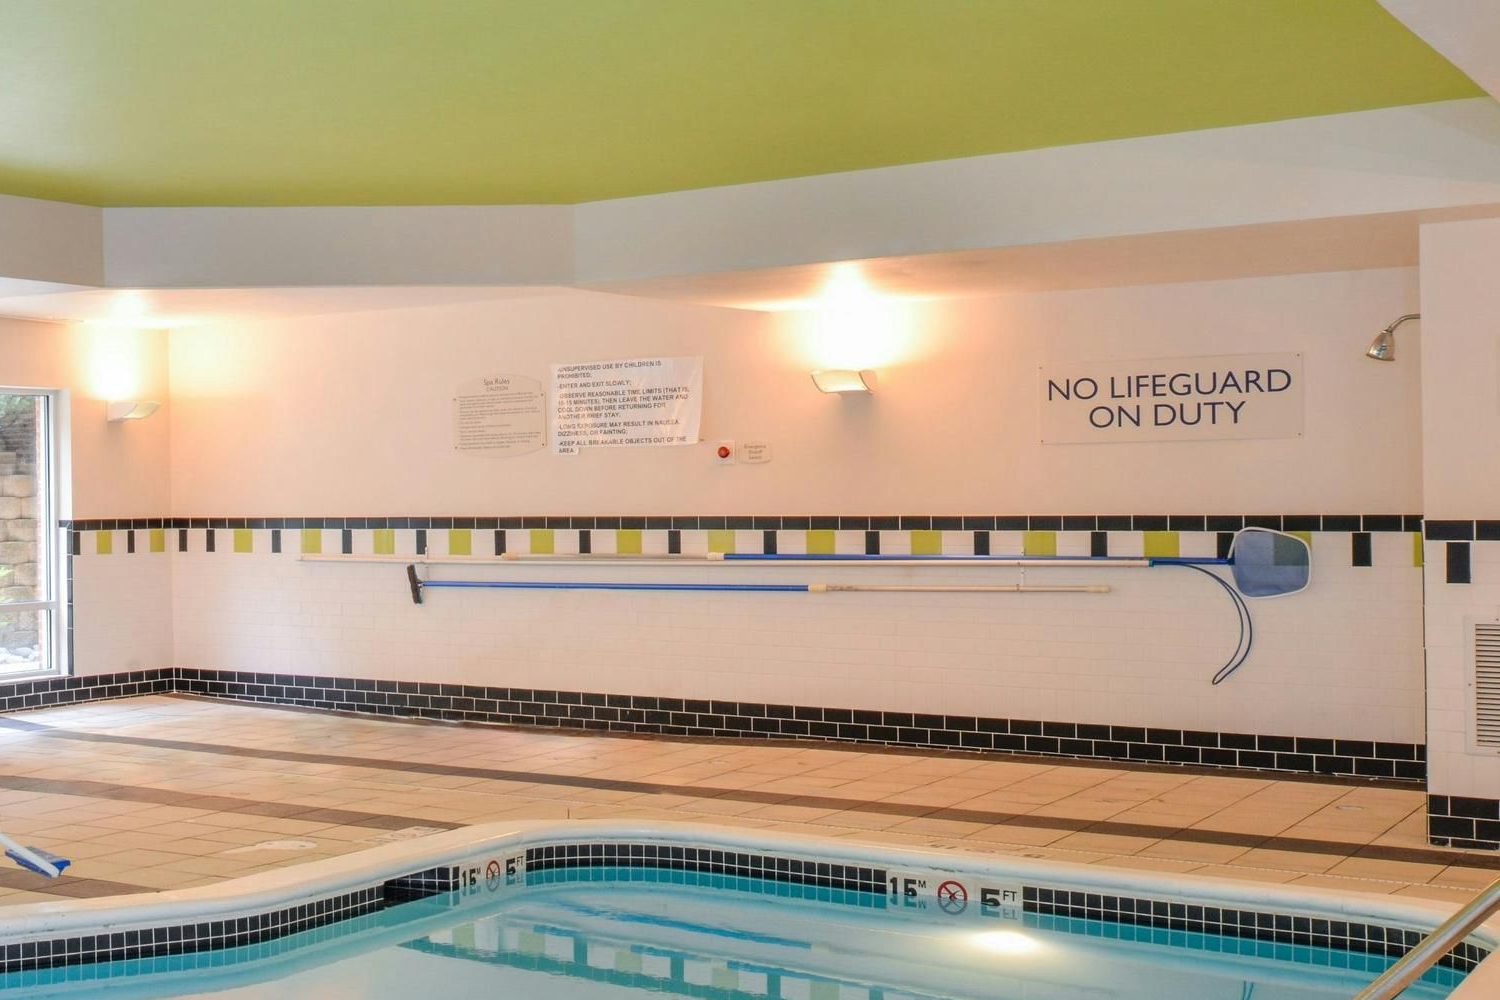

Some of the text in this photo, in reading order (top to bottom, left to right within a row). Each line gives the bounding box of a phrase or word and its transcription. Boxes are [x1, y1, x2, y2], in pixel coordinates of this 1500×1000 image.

[1048, 368, 1292, 401] NO LIFEGUARD
[1089, 401, 1246, 428] ON DUTY
